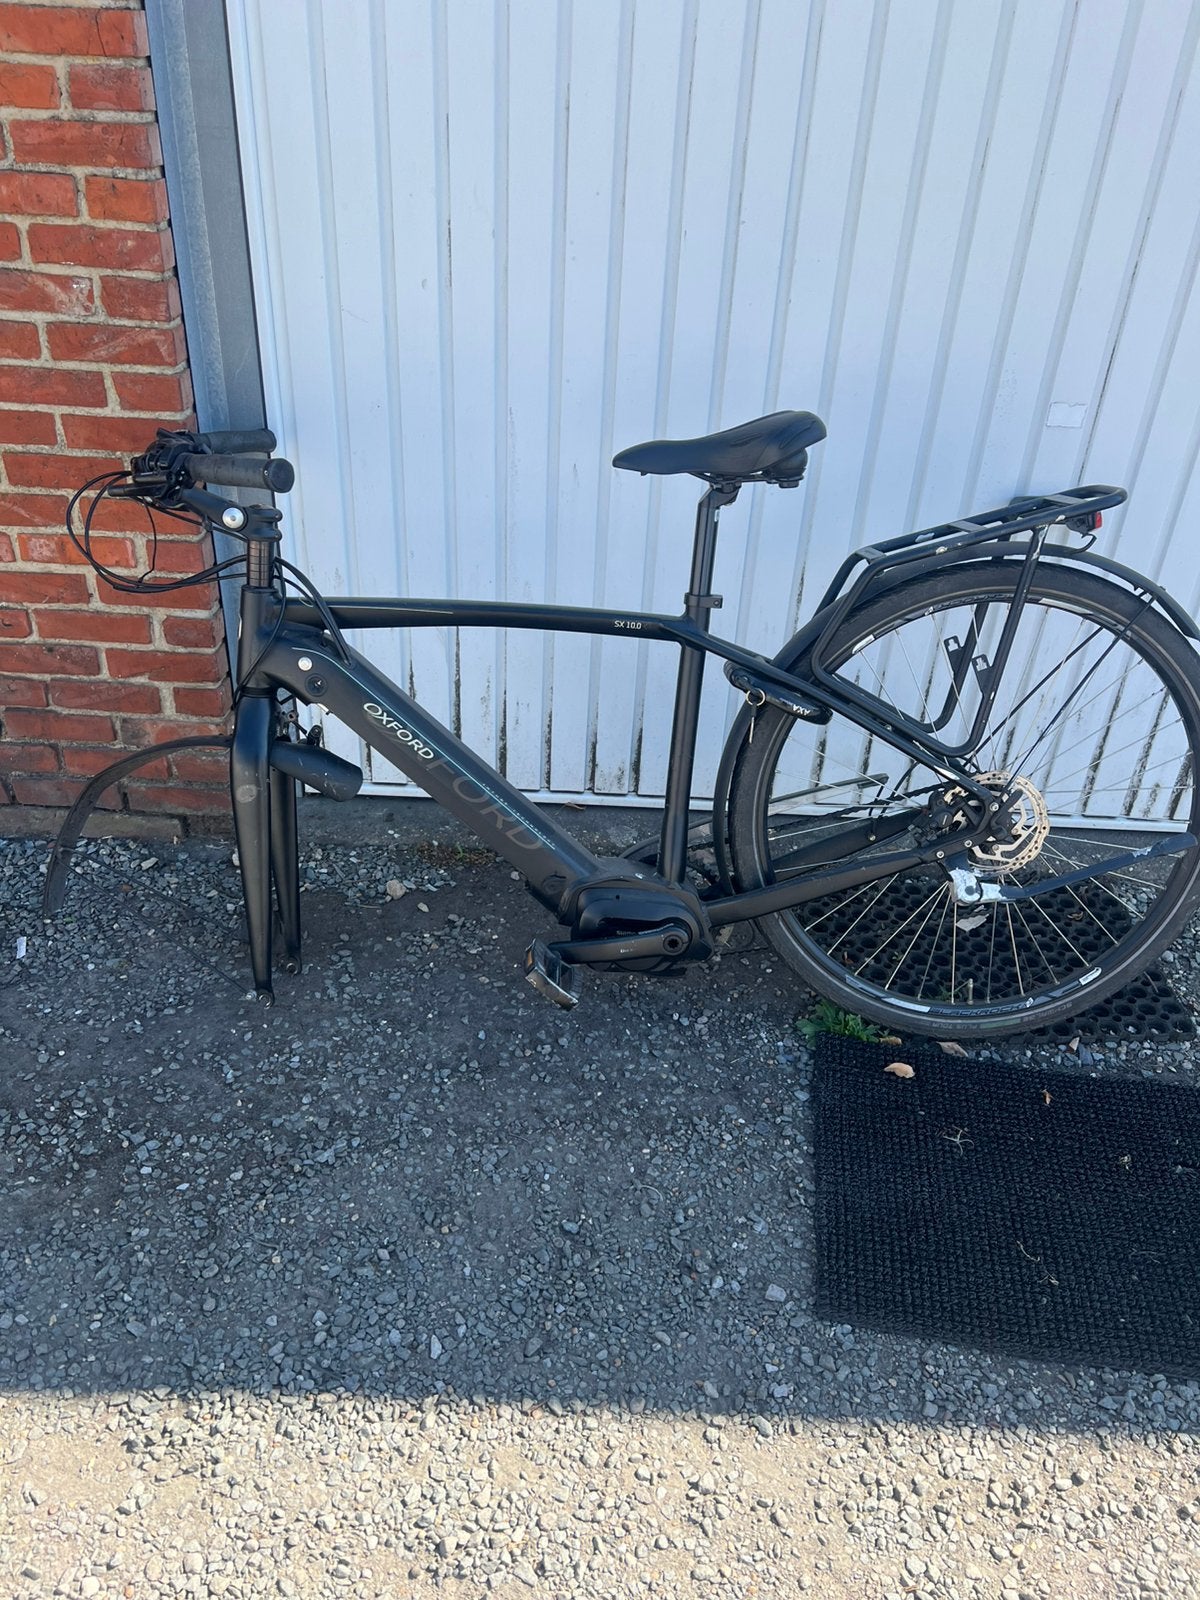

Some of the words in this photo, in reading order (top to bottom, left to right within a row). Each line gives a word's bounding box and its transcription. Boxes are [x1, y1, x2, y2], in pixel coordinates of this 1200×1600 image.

[613, 620, 625, 628] SX
[626, 621, 642, 630] 10.0
[792, 703, 811, 716] AXA
[363, 702, 434, 760] OXFORD
